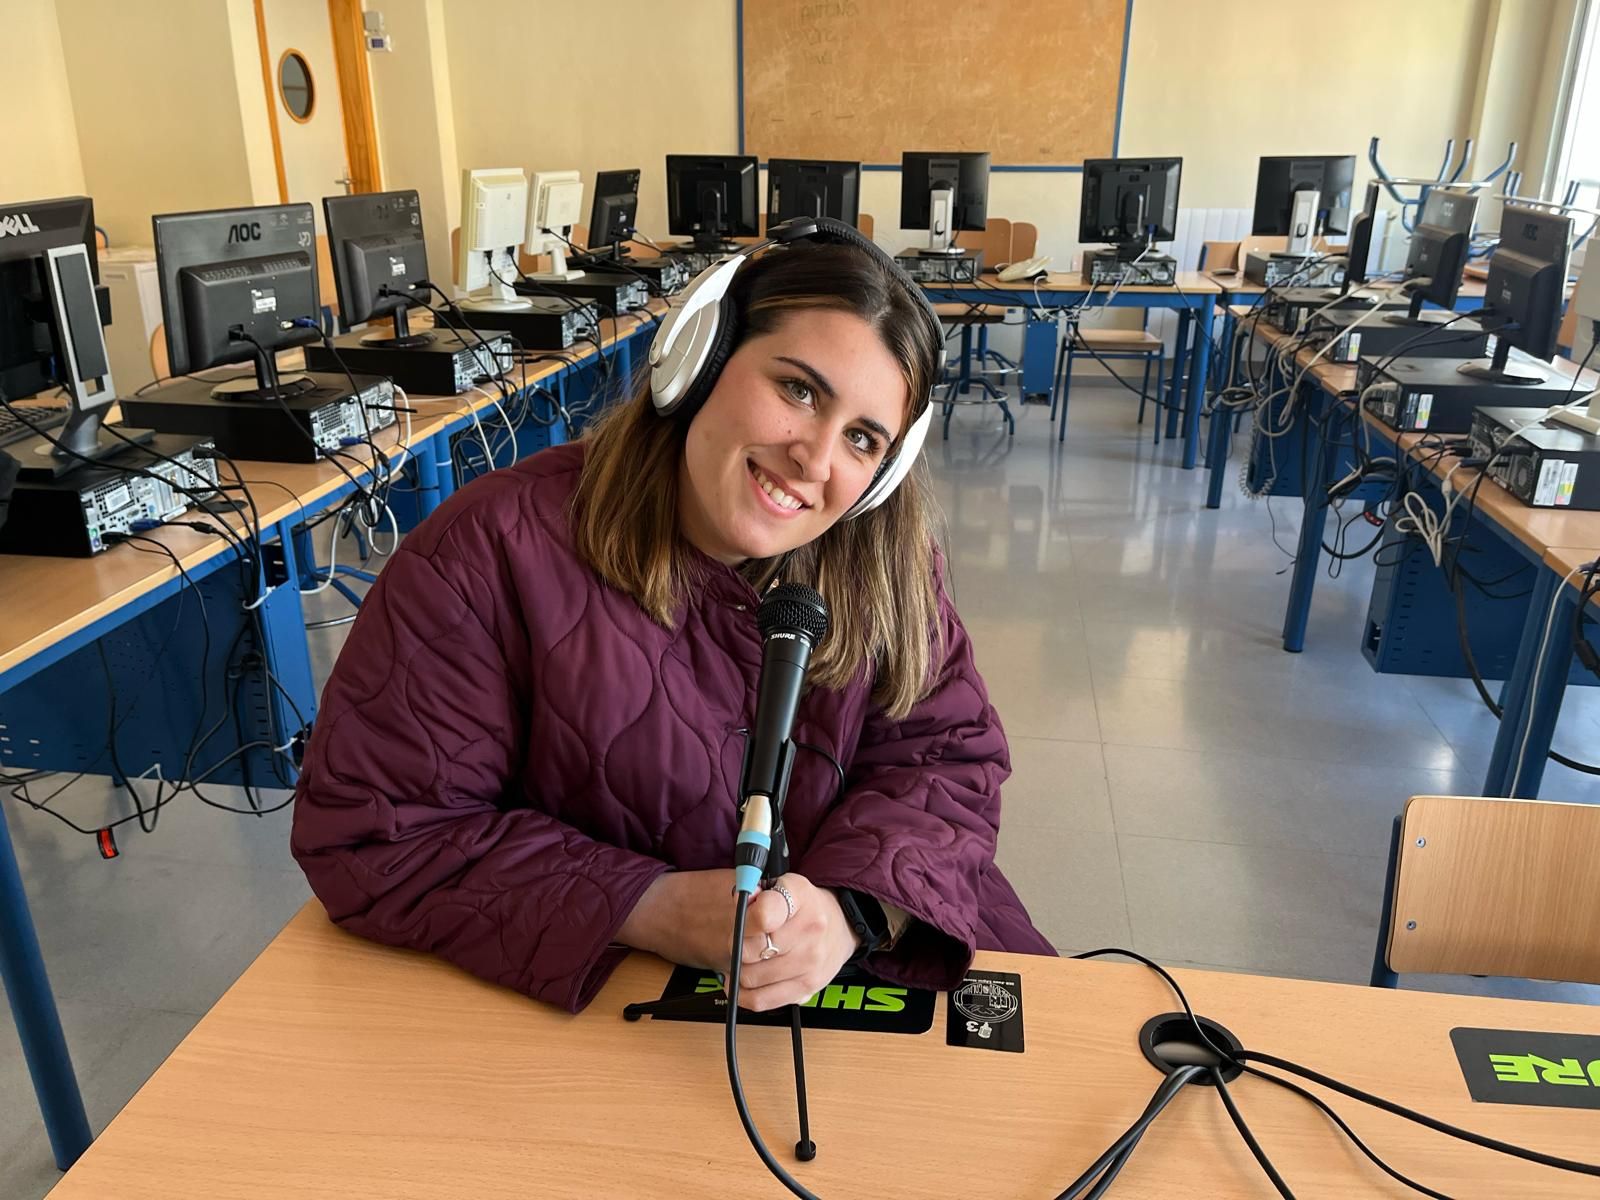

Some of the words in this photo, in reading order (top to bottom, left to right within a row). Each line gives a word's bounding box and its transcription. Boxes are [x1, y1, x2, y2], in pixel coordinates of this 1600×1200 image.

[227, 222, 261, 243] AOC
[770, 632, 796, 640] SHURE
[965, 1020, 979, 1033] 3
